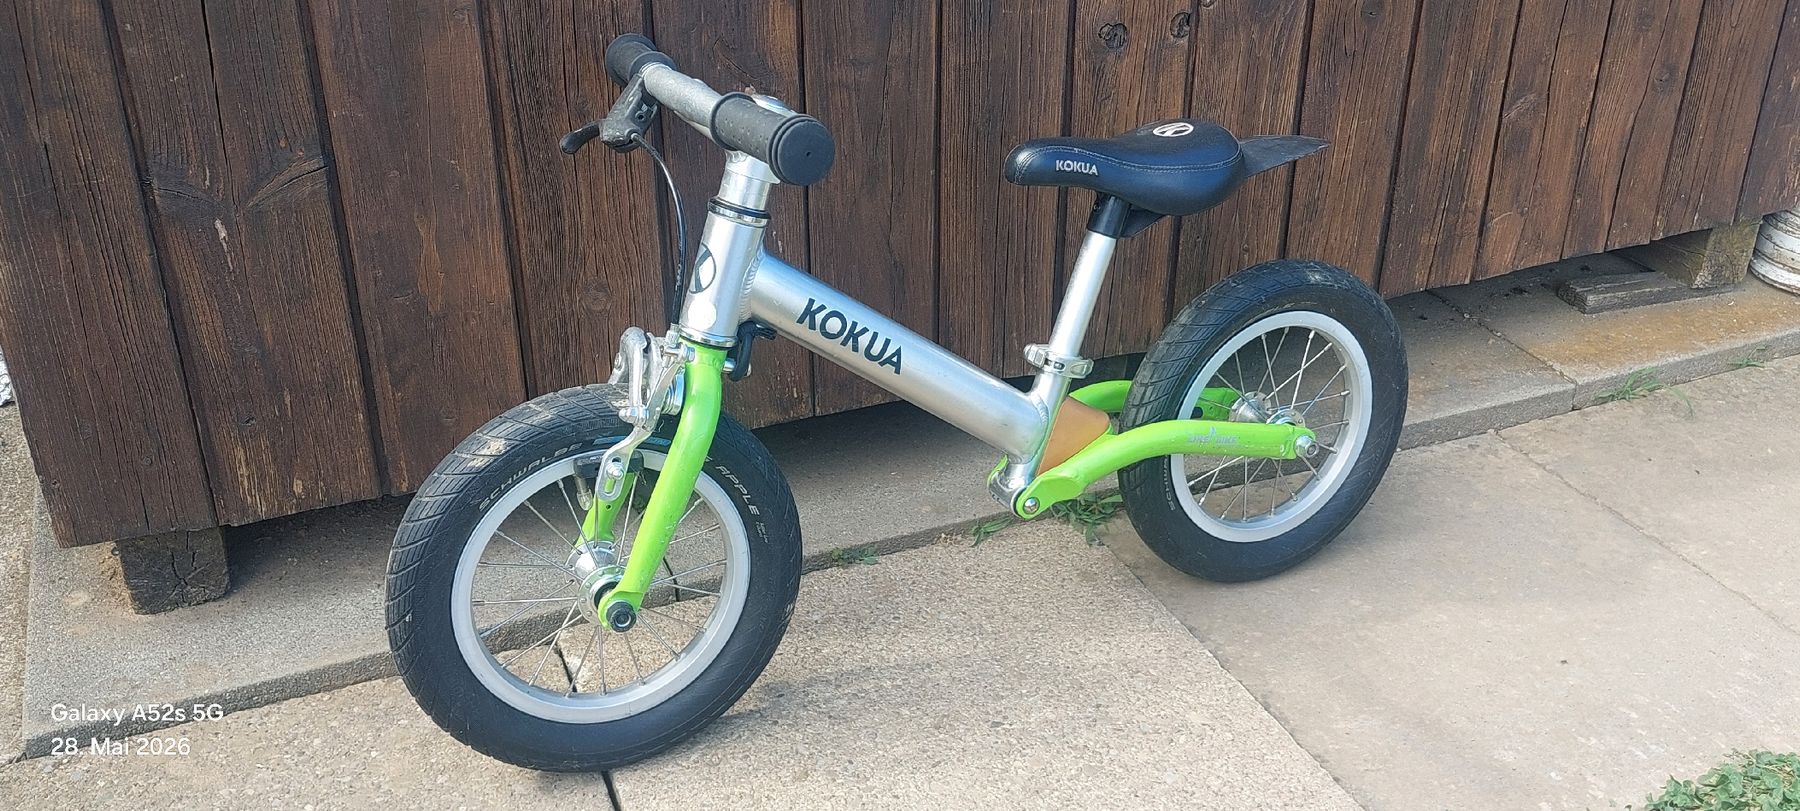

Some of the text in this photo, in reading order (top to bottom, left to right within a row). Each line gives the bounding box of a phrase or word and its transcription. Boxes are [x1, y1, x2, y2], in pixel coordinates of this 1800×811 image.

[1056, 159, 1099, 176] KOKUA
[796, 297, 904, 375] KOKUA
[478, 442, 583, 512] SCHWALBE
[715, 465, 761, 516] APPLE
[1163, 454, 1176, 511] SCHWA
